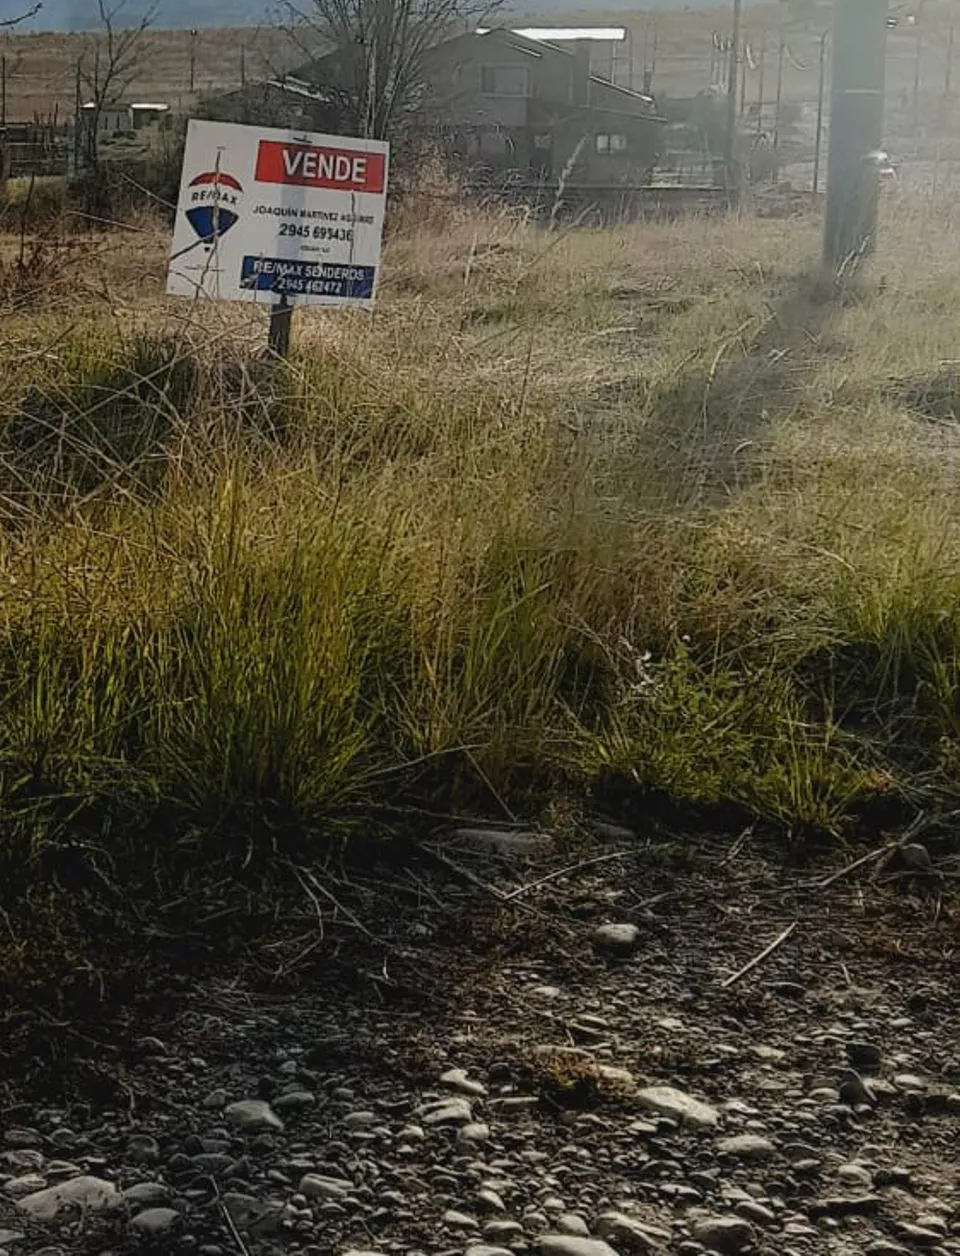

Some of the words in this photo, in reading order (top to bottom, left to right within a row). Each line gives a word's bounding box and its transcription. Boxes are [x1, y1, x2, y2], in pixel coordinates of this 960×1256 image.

[282, 148, 368, 183] VENDE
[191, 190, 238, 205] RE/MAX
[279, 223, 310, 239] 2945
[253, 260, 303, 276] RE/MAX
[304, 265, 365, 281] SENDEROS
